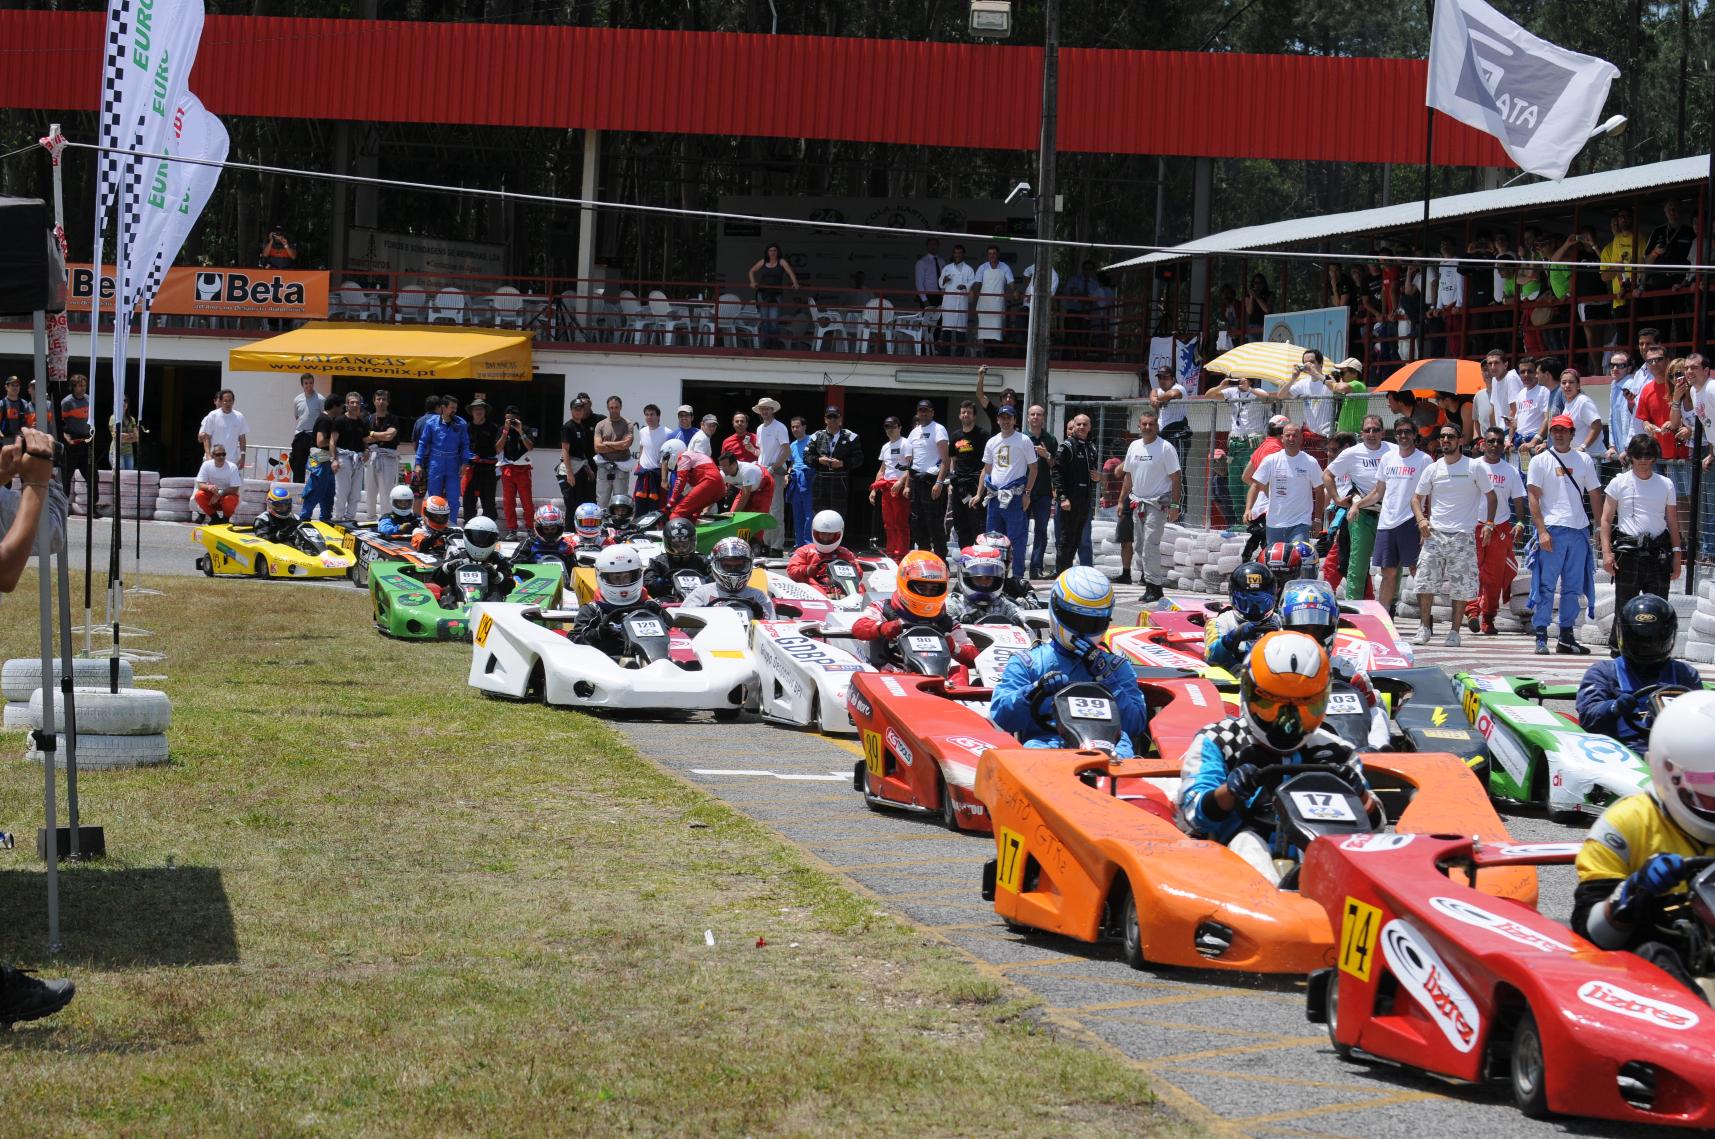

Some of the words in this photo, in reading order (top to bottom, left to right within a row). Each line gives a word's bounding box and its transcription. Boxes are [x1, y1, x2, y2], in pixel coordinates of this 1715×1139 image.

[71, 268, 116, 299] Be
[226, 273, 305, 304] Beta
[269, 362, 437, 377] www.pestronix.pt
[1385, 465, 1416, 476] UNITRIP
[1487, 473, 1506, 484] TRIP
[1248, 574, 1261, 583] tvi
[636, 621, 656, 629] 129
[1074, 698, 1105, 709] 39
[865, 733, 879, 772] 39
[1302, 793, 1333, 806] 17
[998, 833, 1020, 884] 17
[1344, 903, 1372, 973] 74
